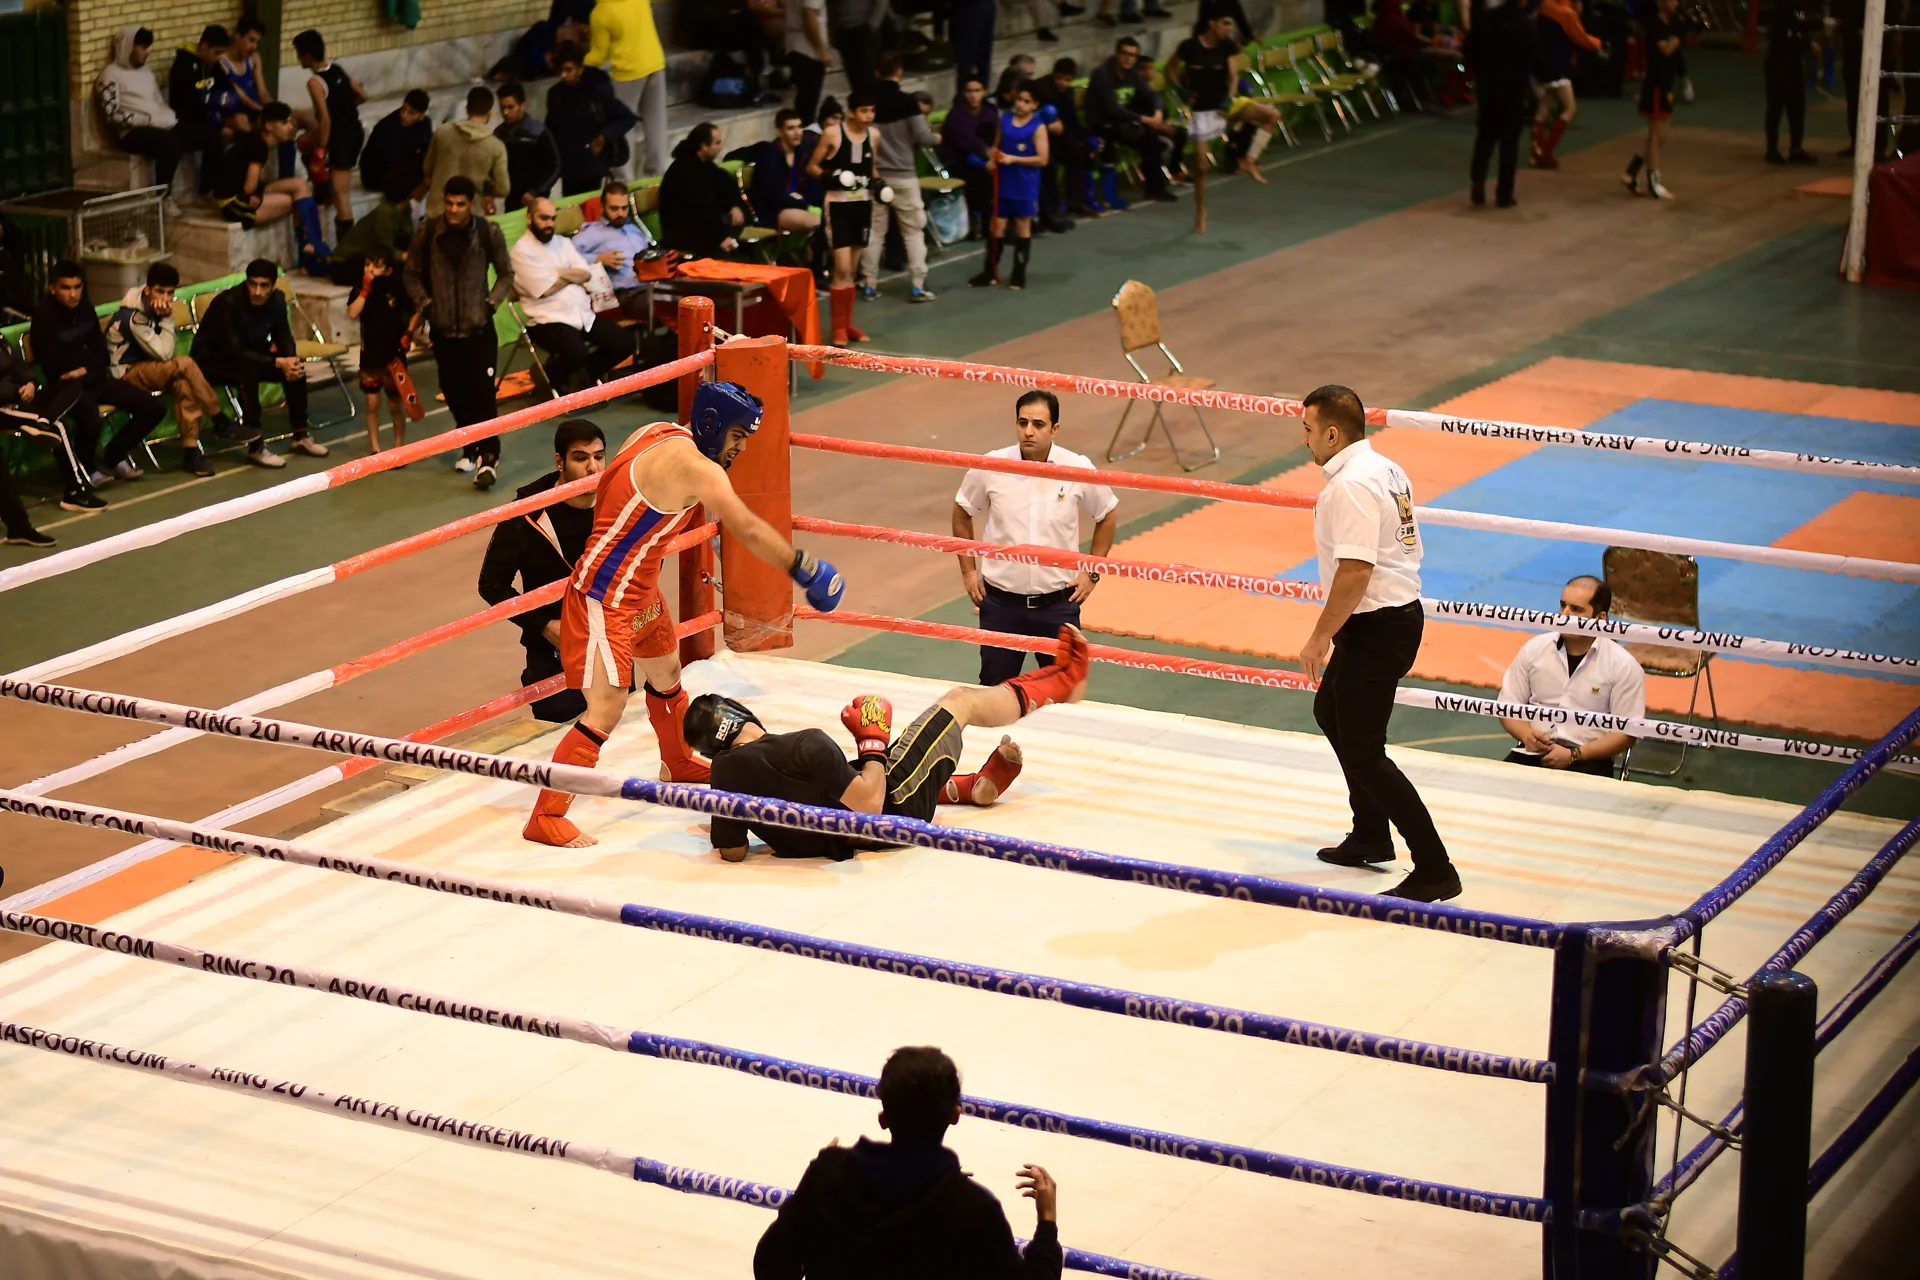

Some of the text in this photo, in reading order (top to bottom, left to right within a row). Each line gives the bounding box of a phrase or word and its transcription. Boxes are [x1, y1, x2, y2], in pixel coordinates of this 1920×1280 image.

[1440, 418, 1576, 445] GHAHREMAN
[1581, 433, 1638, 451] ARYA
[1436, 600, 1571, 627] GHAHREMAN
[1577, 616, 1631, 636] ARYA
[1657, 627, 1686, 641] 20
[1693, 630, 1745, 650] RING
[1434, 695, 1568, 724] GHAHREMAN
[1574, 711, 1630, 732] ARYA
[715, 716, 732, 741] RDX
[1655, 721, 1684, 739] 20
[1689, 727, 1740, 747] RING
[185, 709, 243, 736] RING
[249, 719, 281, 743] 20
[312, 730, 376, 759] ARYA
[384, 742, 553, 788] GHAHREMAN
[202, 952, 258, 980] RING
[328, 976, 391, 1005] ARYA
[1284, 1022, 1370, 1057] ARYA
[406, 1108, 572, 1158] GHAHREMAN
